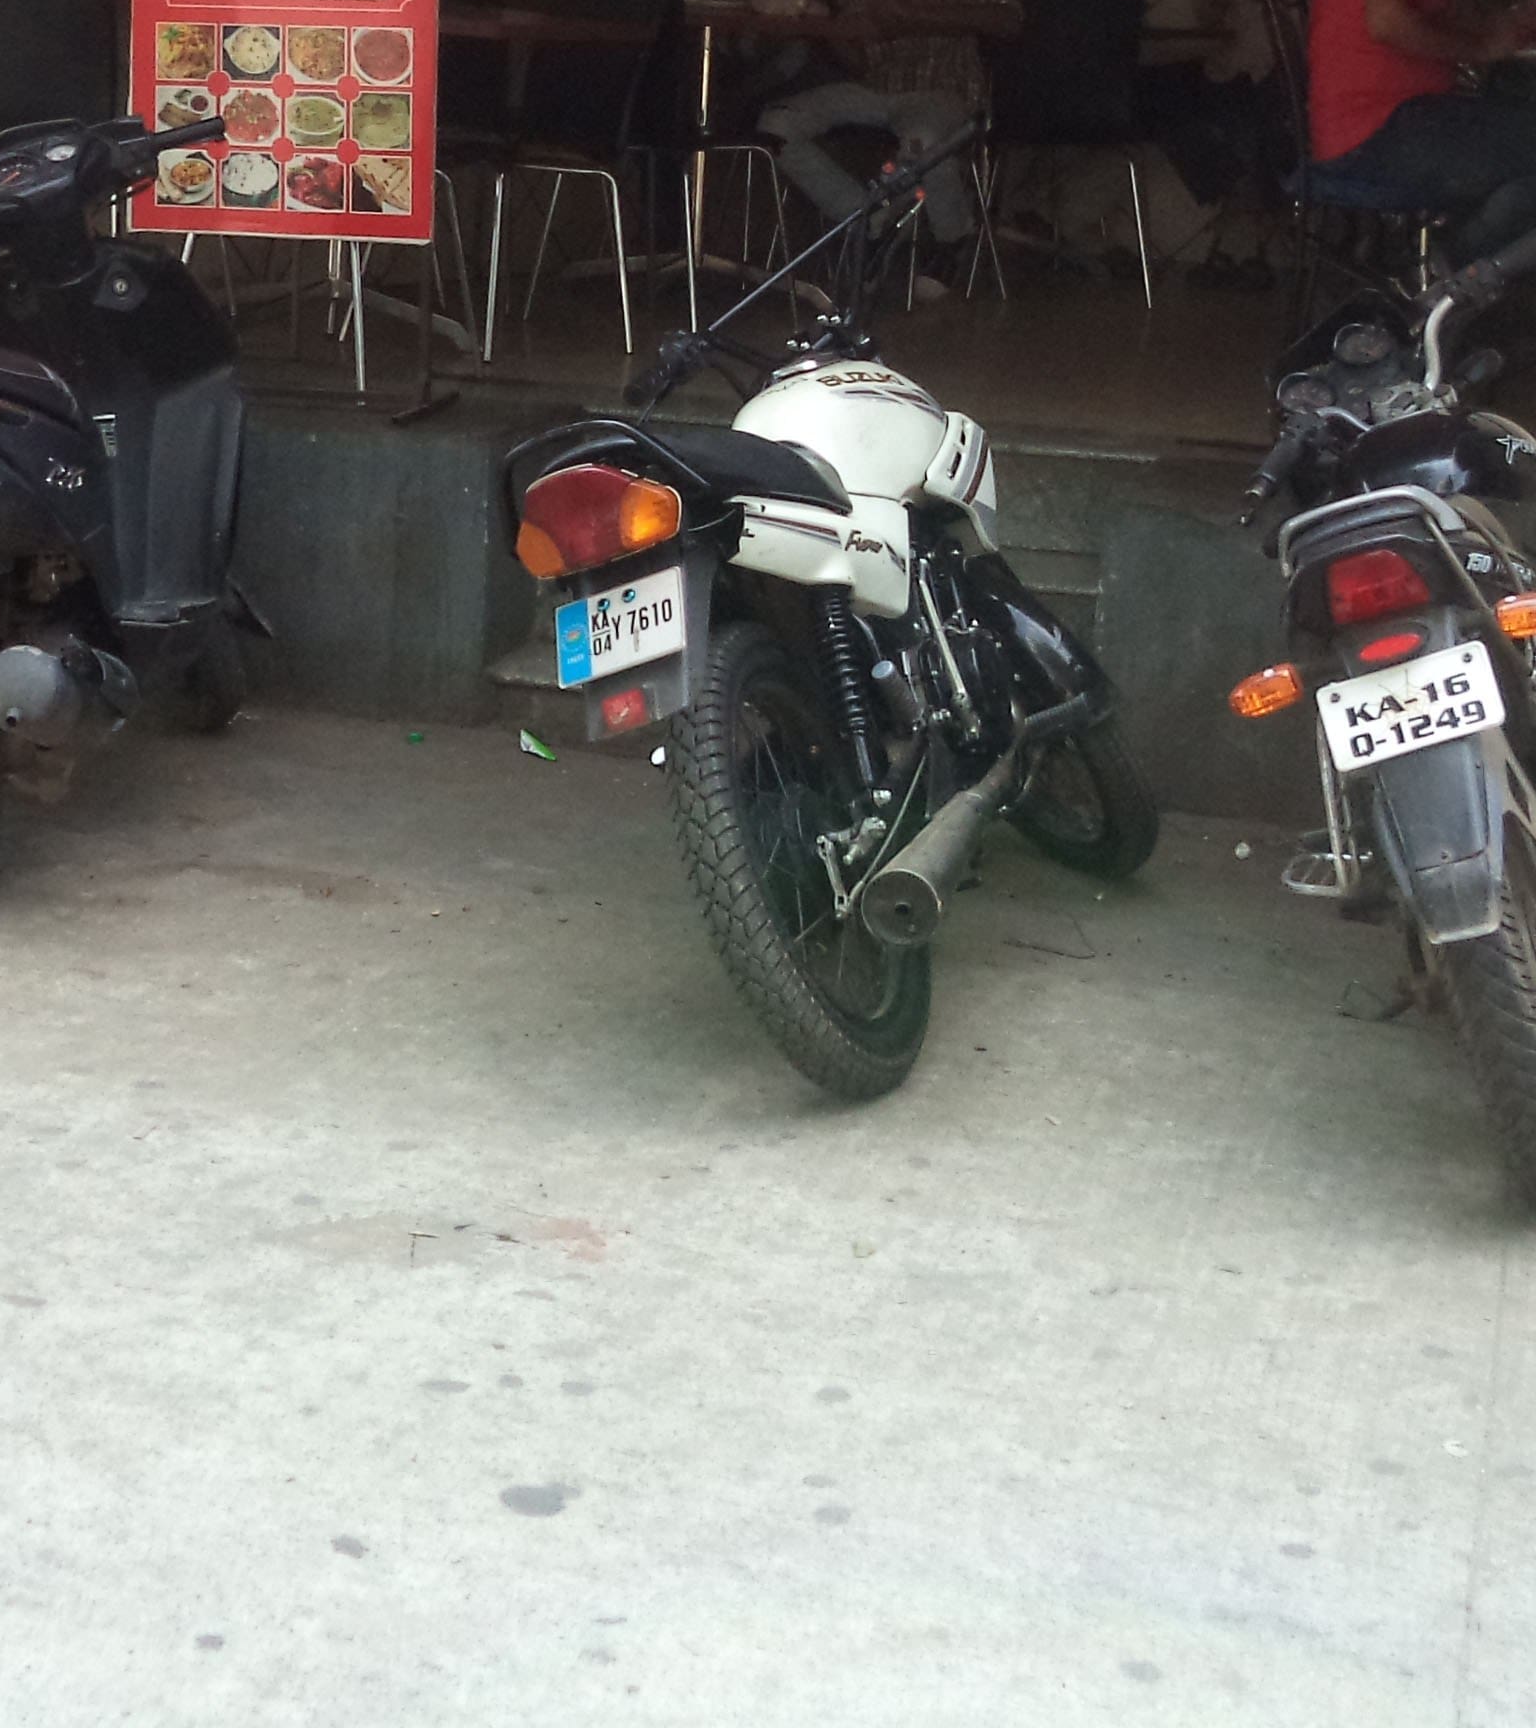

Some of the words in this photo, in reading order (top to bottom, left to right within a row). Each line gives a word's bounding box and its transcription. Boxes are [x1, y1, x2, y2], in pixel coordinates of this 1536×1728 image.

[591, 610, 610, 633] KA
[611, 615, 622, 641] Y
[626, 598, 673, 636] 7610
[593, 633, 612, 657] 04
[1345, 672, 1471, 728] KA-16
